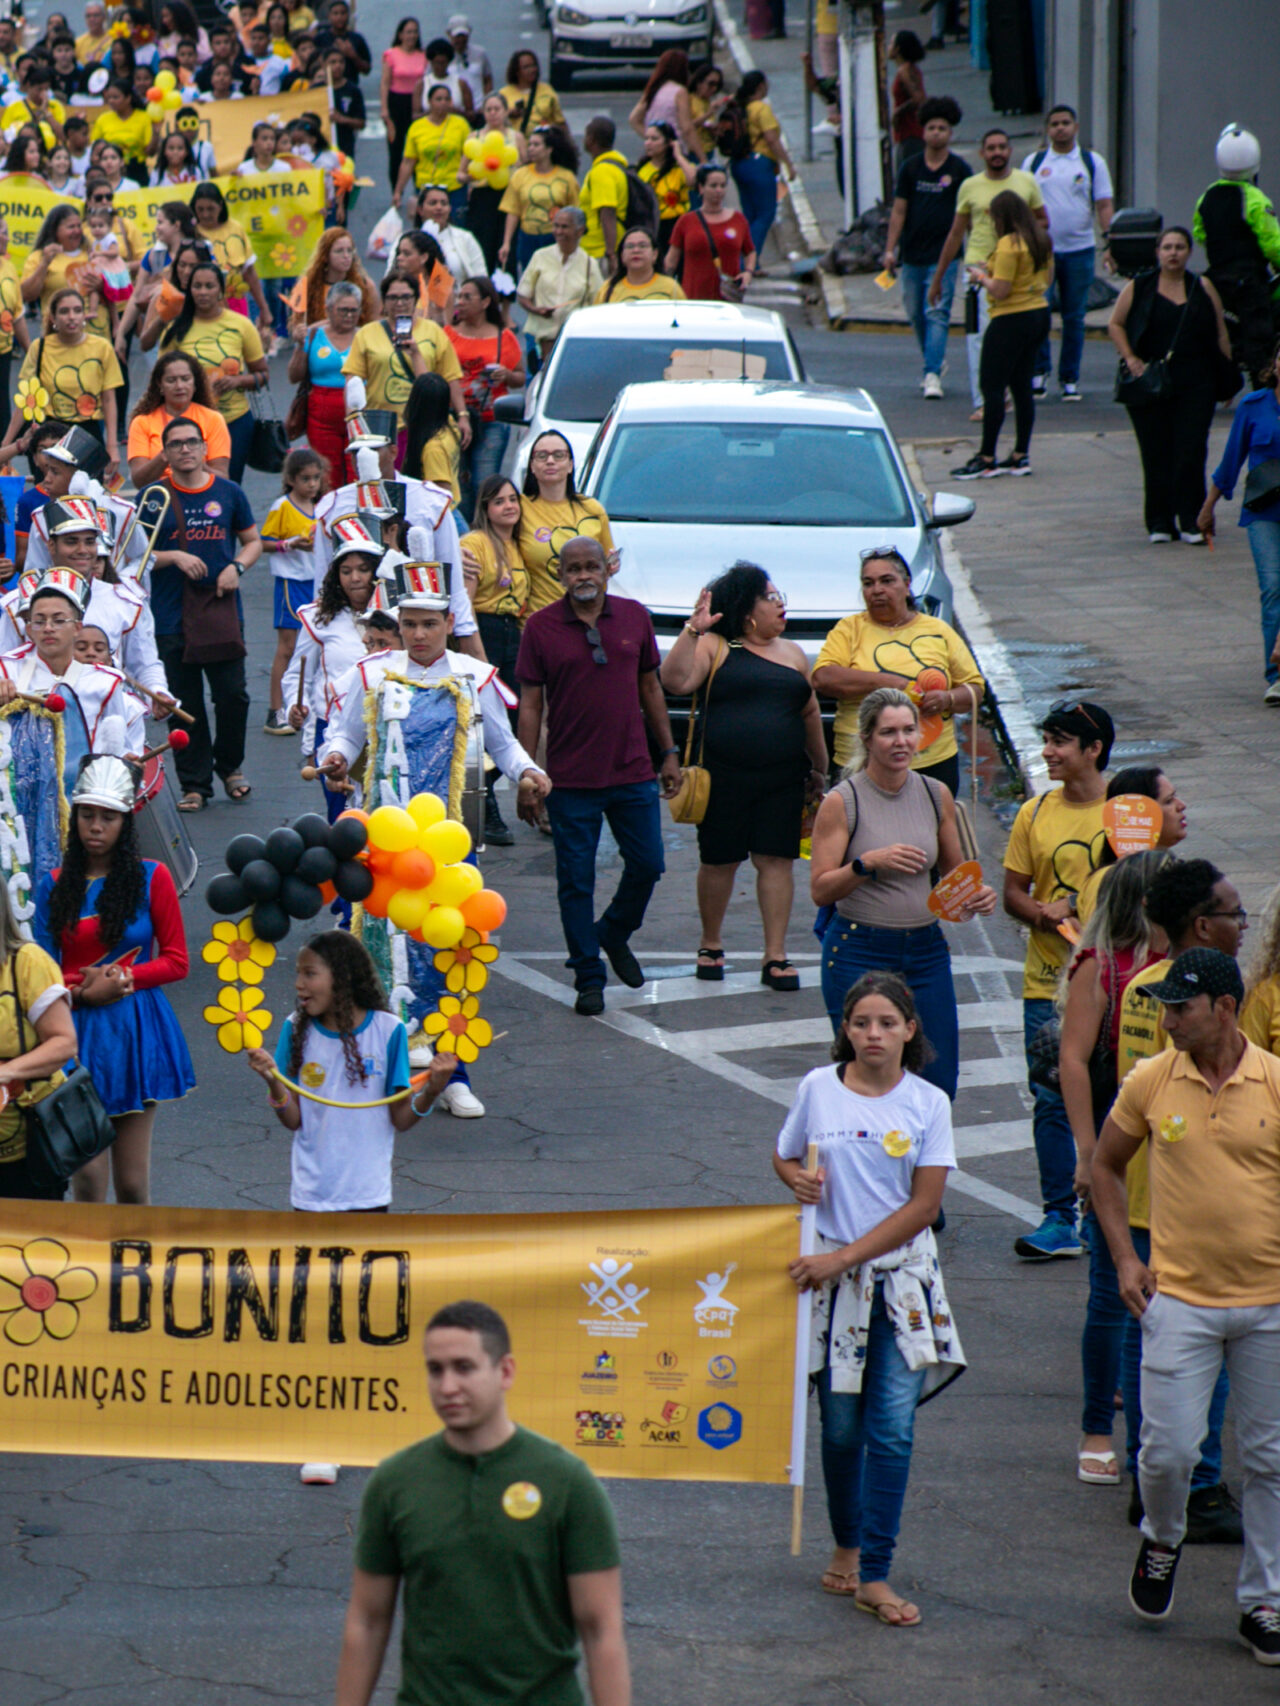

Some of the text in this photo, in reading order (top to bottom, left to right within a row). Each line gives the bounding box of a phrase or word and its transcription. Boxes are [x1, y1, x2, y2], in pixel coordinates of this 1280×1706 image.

[225, 182, 310, 203] CONTRA
[109, 1239, 410, 1345] BONITO
[699, 1327, 731, 1338] Brasil
[3, 1362, 146, 1409] CRIANÇAS
[161, 1370, 173, 1403] E
[185, 1371, 407, 1412] ADOLESCENTES.
